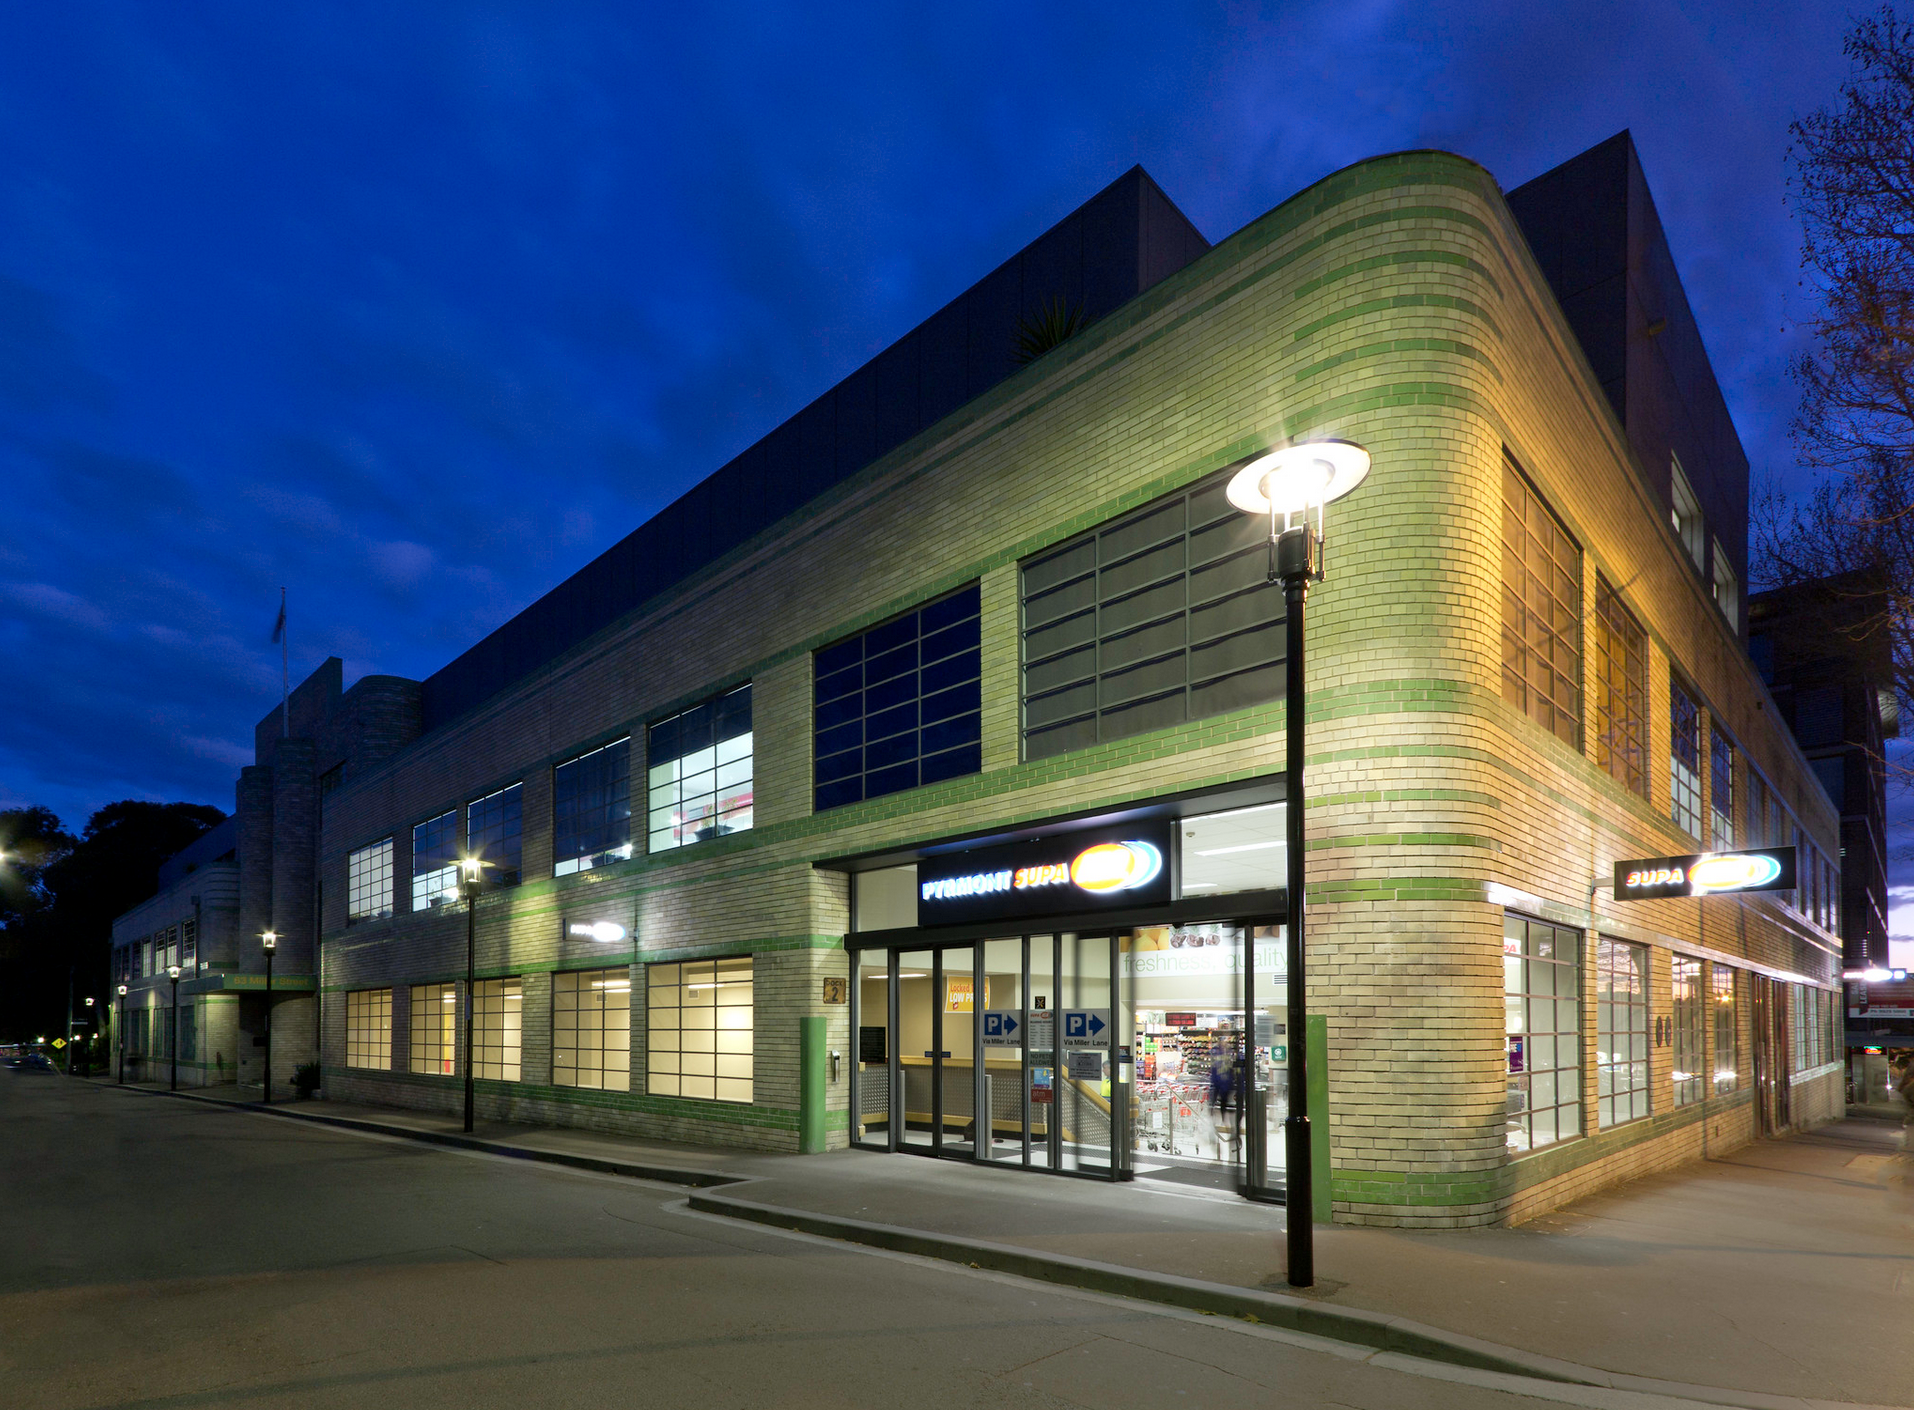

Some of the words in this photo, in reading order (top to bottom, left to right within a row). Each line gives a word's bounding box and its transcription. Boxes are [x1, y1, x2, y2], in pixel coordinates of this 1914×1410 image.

[922, 871, 1013, 900] PYRMONT
[1013, 862, 1069, 889] SUPA
[1626, 867, 1684, 887] SUPA
[1225, 947, 1287, 974] quality
[234, 976, 247, 985] 63
[250, 976, 276, 985] Millr
[279, 977, 309, 986] Street
[951, 984, 970, 992] Locked
[831, 986, 839, 1001] 2
[950, 992, 965, 1002] LOW
[988, 1017, 999, 1033] P
[1070, 1017, 1082, 1033] P
